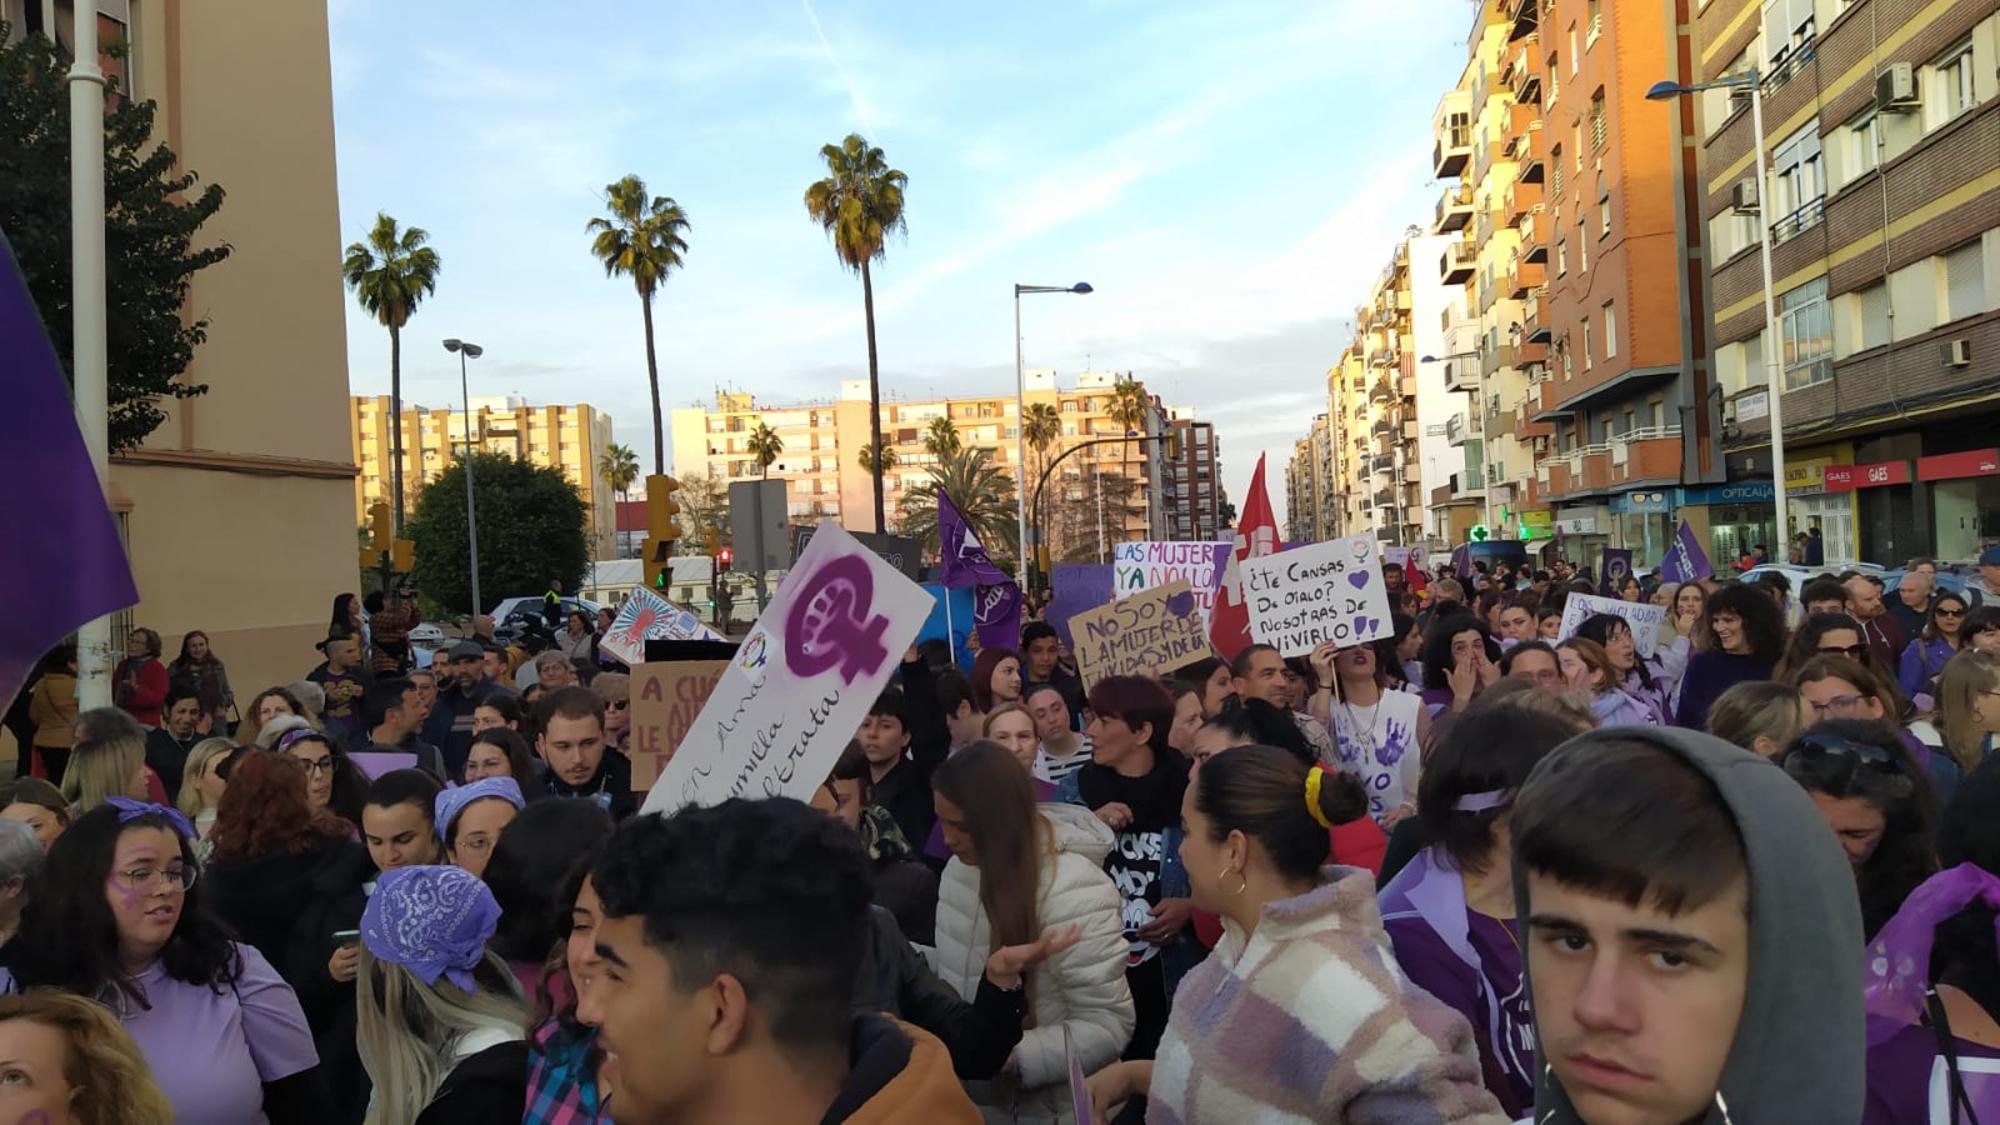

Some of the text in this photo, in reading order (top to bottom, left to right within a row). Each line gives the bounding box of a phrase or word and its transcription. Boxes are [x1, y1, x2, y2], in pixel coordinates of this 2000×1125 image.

[1868, 466, 1888, 482] GAES
[1115, 542, 1214, 565] LAS MUJER
[1116, 566, 1145, 590] YA
[1086, 614, 1119, 642] NO
[641, 676, 663, 702] A
[638, 726, 661, 752] LE
[763, 690, 839, 798] ltrata
[728, 713, 785, 799] umilla
